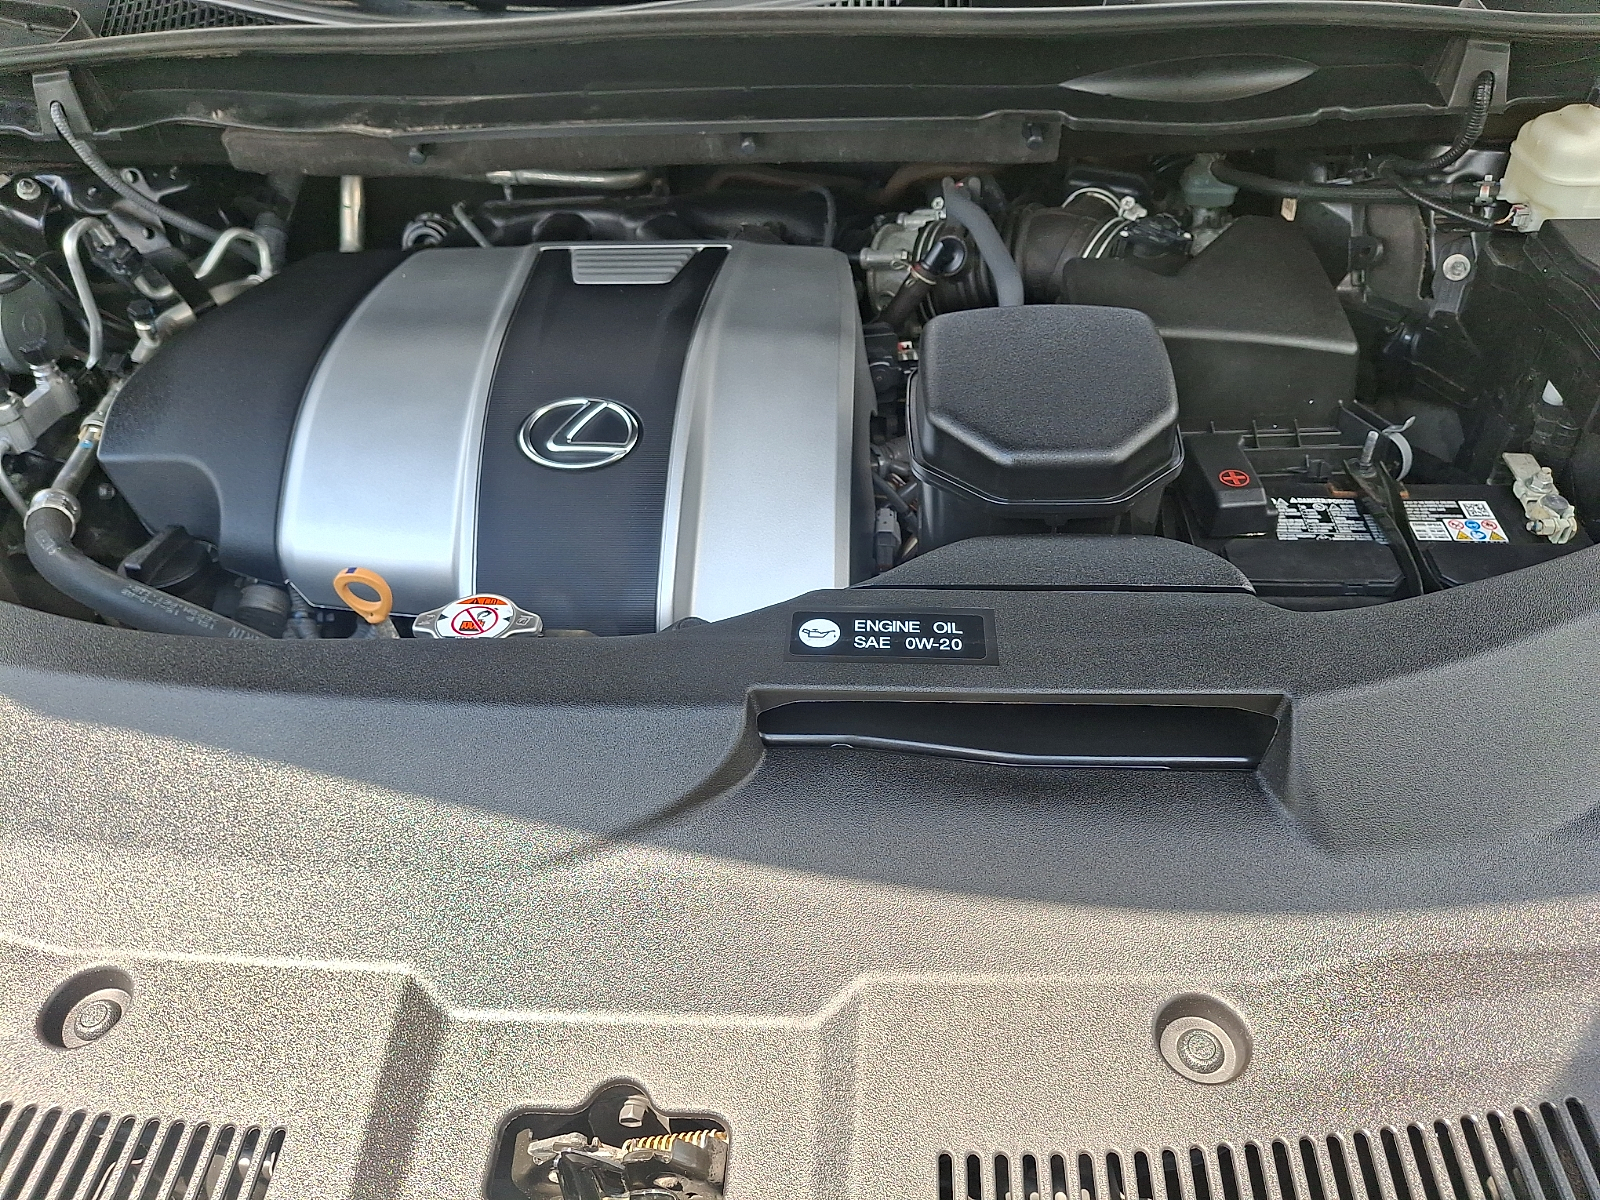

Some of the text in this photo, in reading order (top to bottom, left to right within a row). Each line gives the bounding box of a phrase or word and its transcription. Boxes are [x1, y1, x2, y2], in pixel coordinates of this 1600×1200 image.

[854, 619, 963, 634] ENGINE OIL
[853, 636, 963, 650] SAE 0W-20
